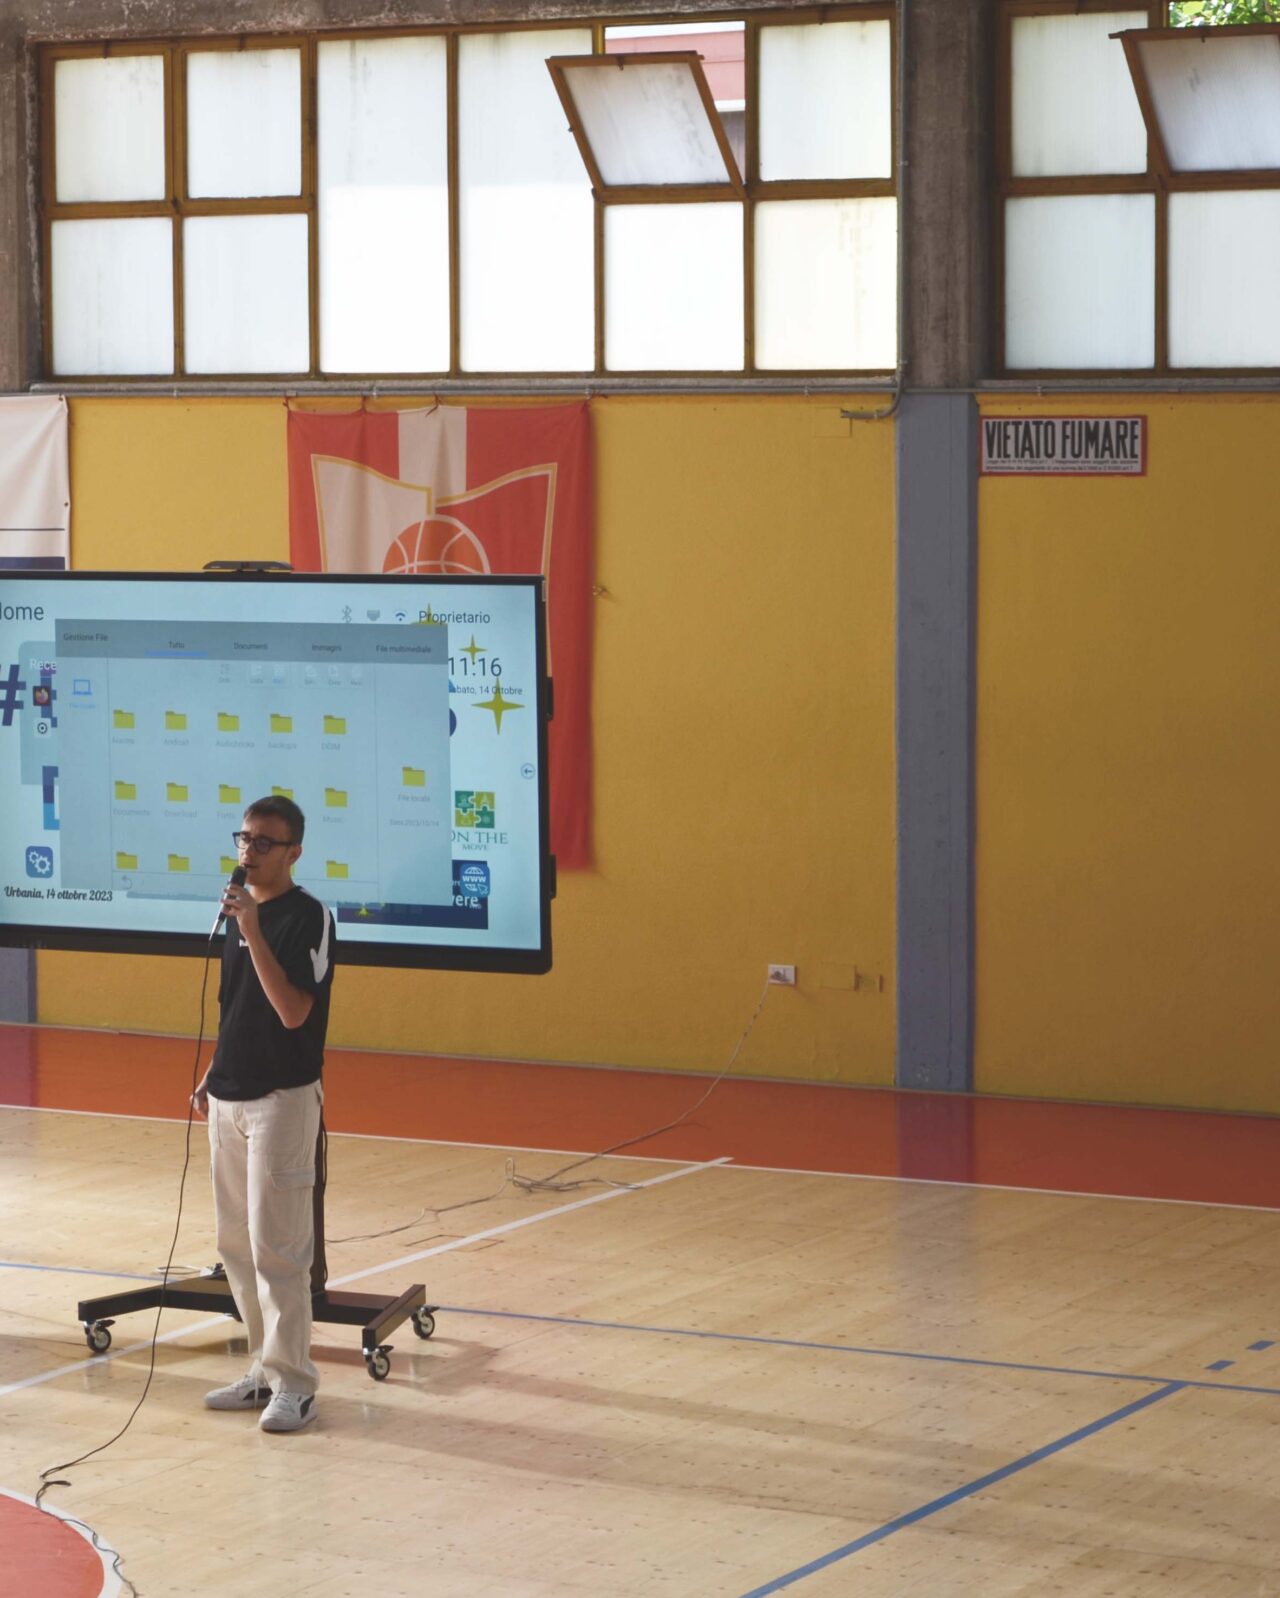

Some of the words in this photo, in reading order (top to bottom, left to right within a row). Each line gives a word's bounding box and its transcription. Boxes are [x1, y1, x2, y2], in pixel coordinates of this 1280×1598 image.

[985, 420, 1056, 459] VIETATO
[1061, 420, 1139, 459] FUMARE
[419, 610, 491, 625] Proprietario
[479, 685, 490, 694] 14
[475, 831, 509, 845] THE
[4, 886, 44, 899] Urbania,
[46, 888, 56, 899] 14
[57, 889, 87, 900] ottobre
[89, 890, 113, 902] 2023
